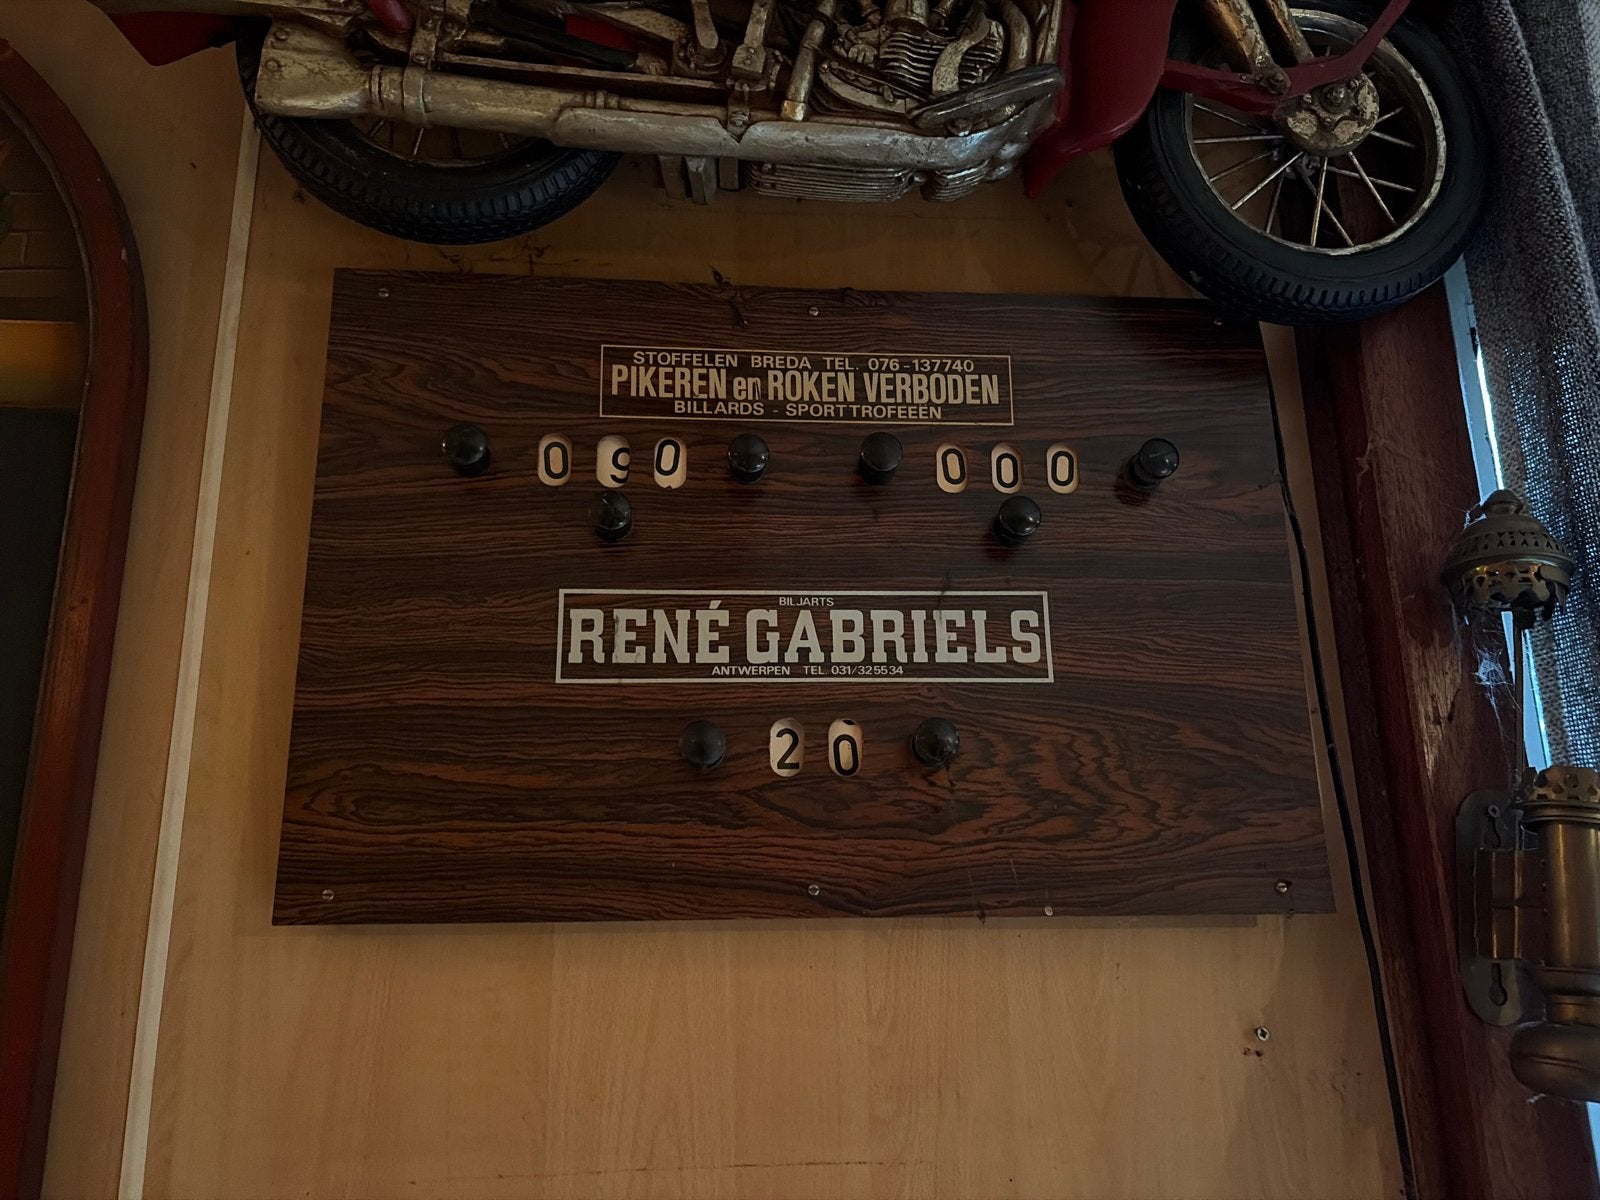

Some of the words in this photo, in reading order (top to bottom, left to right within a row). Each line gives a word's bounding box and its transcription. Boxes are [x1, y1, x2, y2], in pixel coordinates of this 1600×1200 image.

[633, 351, 738, 367] STOFFELEN
[751, 355, 812, 369] BREDA
[823, 357, 859, 370] TEL.
[611, 364, 727, 399] PIKEREN
[733, 376, 762, 400] en
[767, 370, 855, 402] ROKEN
[863, 372, 1000, 405] VERBODEN
[674, 400, 765, 416] BILLARDS
[779, 597, 834, 607] BILJARTS
[568, 600, 730, 664] RENÉ
[746, 609, 1042, 664] GABRIELS
[712, 665, 791, 676] ANTWERPEN
